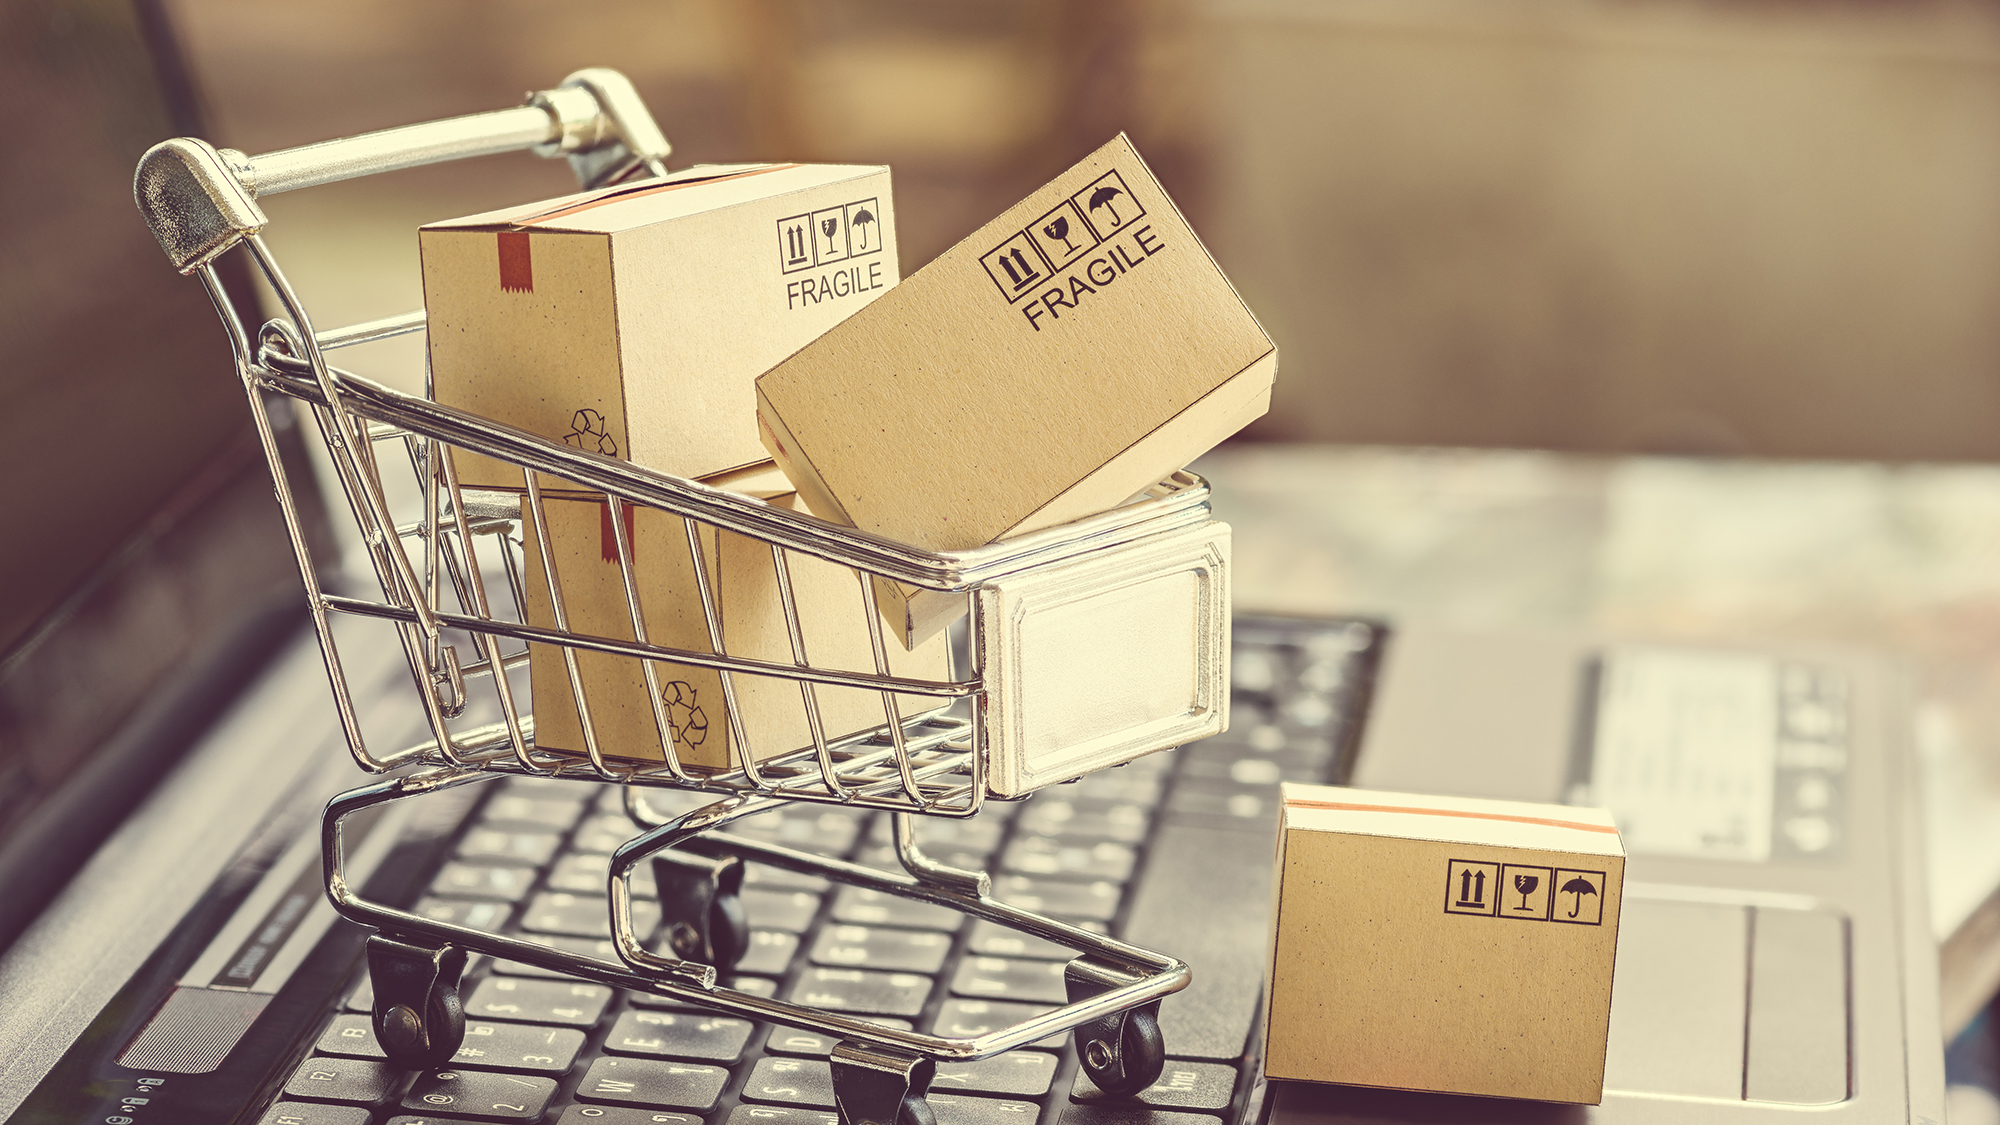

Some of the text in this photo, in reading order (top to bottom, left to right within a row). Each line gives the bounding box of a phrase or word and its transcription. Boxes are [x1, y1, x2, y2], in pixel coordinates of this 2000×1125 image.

[1022, 225, 1165, 332] FRAGILE
[787, 261, 884, 311] FRAGILE
[623, 1037, 661, 1048] E
[785, 1036, 822, 1048] D
[457, 1047, 486, 1058] #
[522, 1055, 554, 1065] 3
[309, 1071, 337, 1082] F2
[934, 1072, 970, 1084] X
[595, 1079, 635, 1093] W
[763, 1085, 798, 1097] S
[423, 1094, 454, 1106] @
[492, 1103, 525, 1113] 2
[276, 1116, 304, 1125] F1
